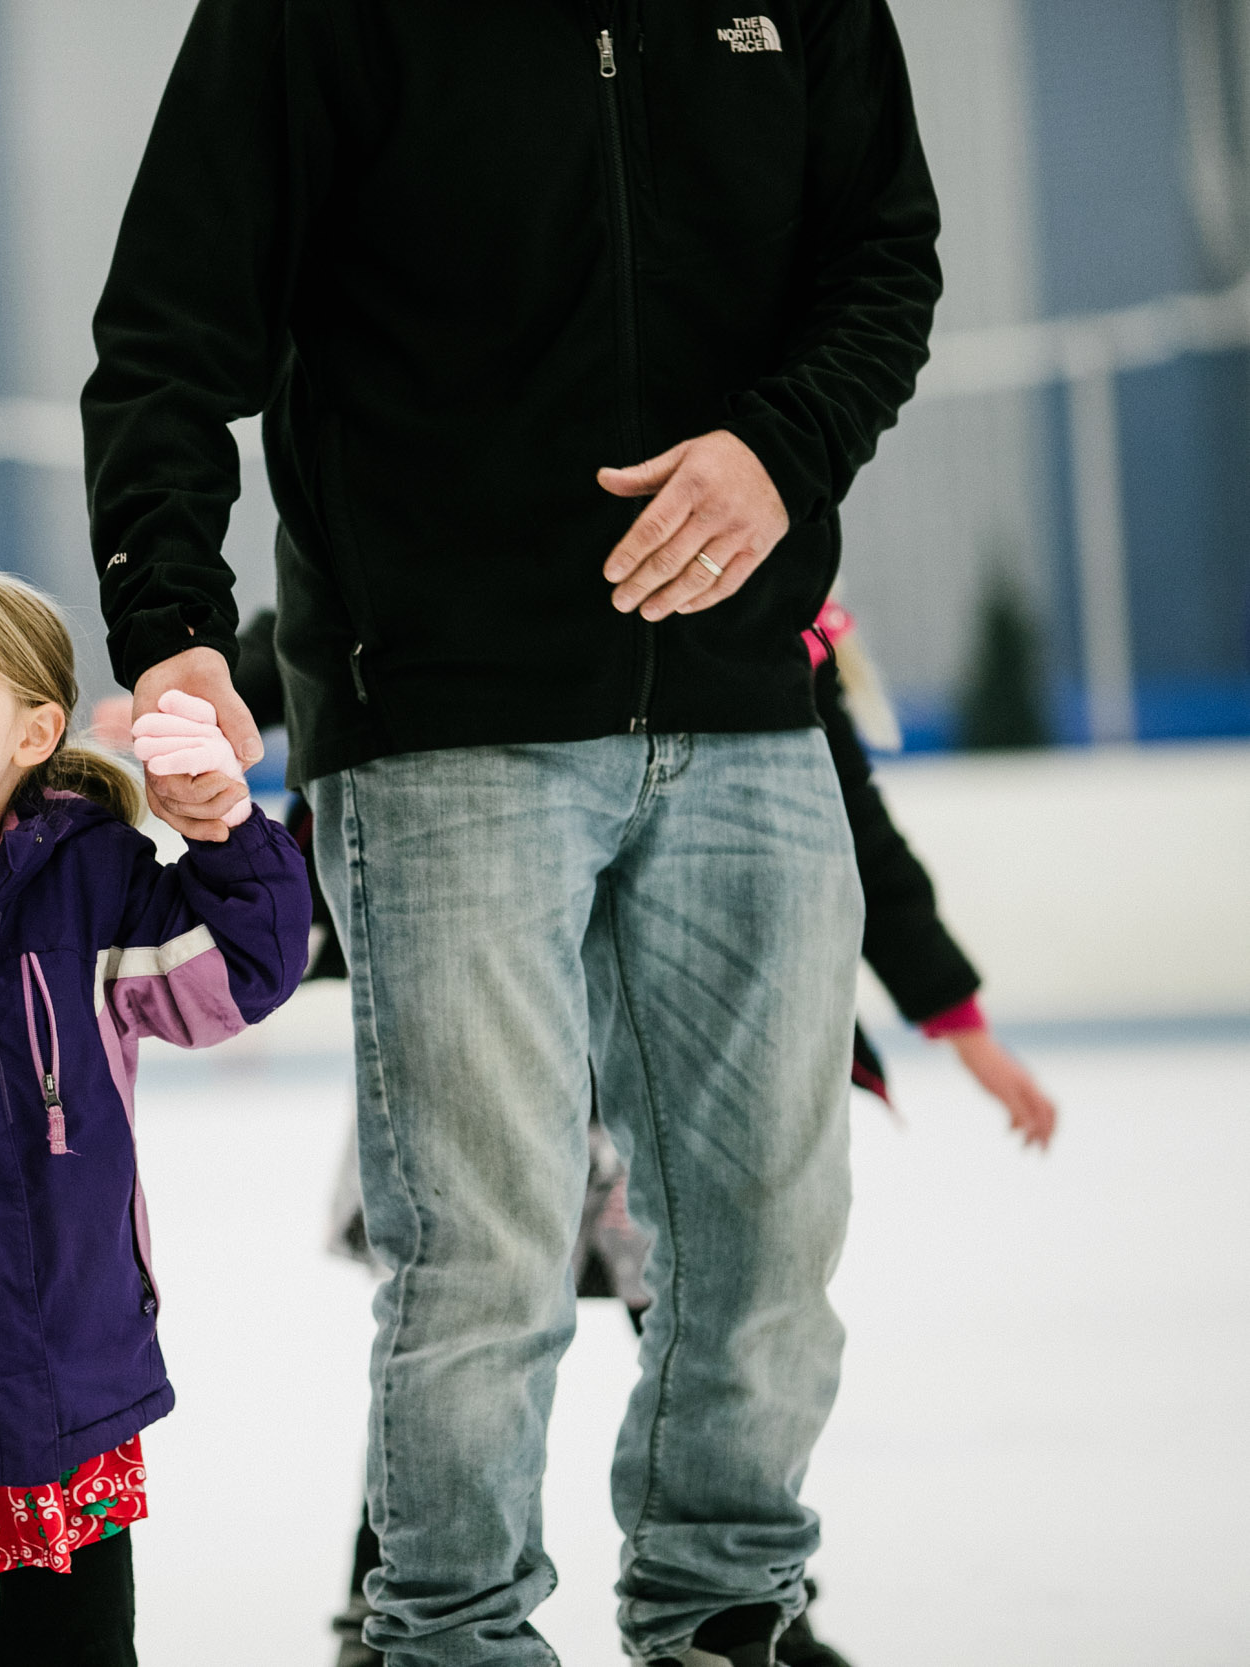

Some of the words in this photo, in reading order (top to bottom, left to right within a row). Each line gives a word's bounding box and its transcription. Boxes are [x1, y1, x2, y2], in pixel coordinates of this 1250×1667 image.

[732, 17, 759, 28] THE
[717, 28, 762, 41] NORTH
[731, 40, 764, 53] FACE
